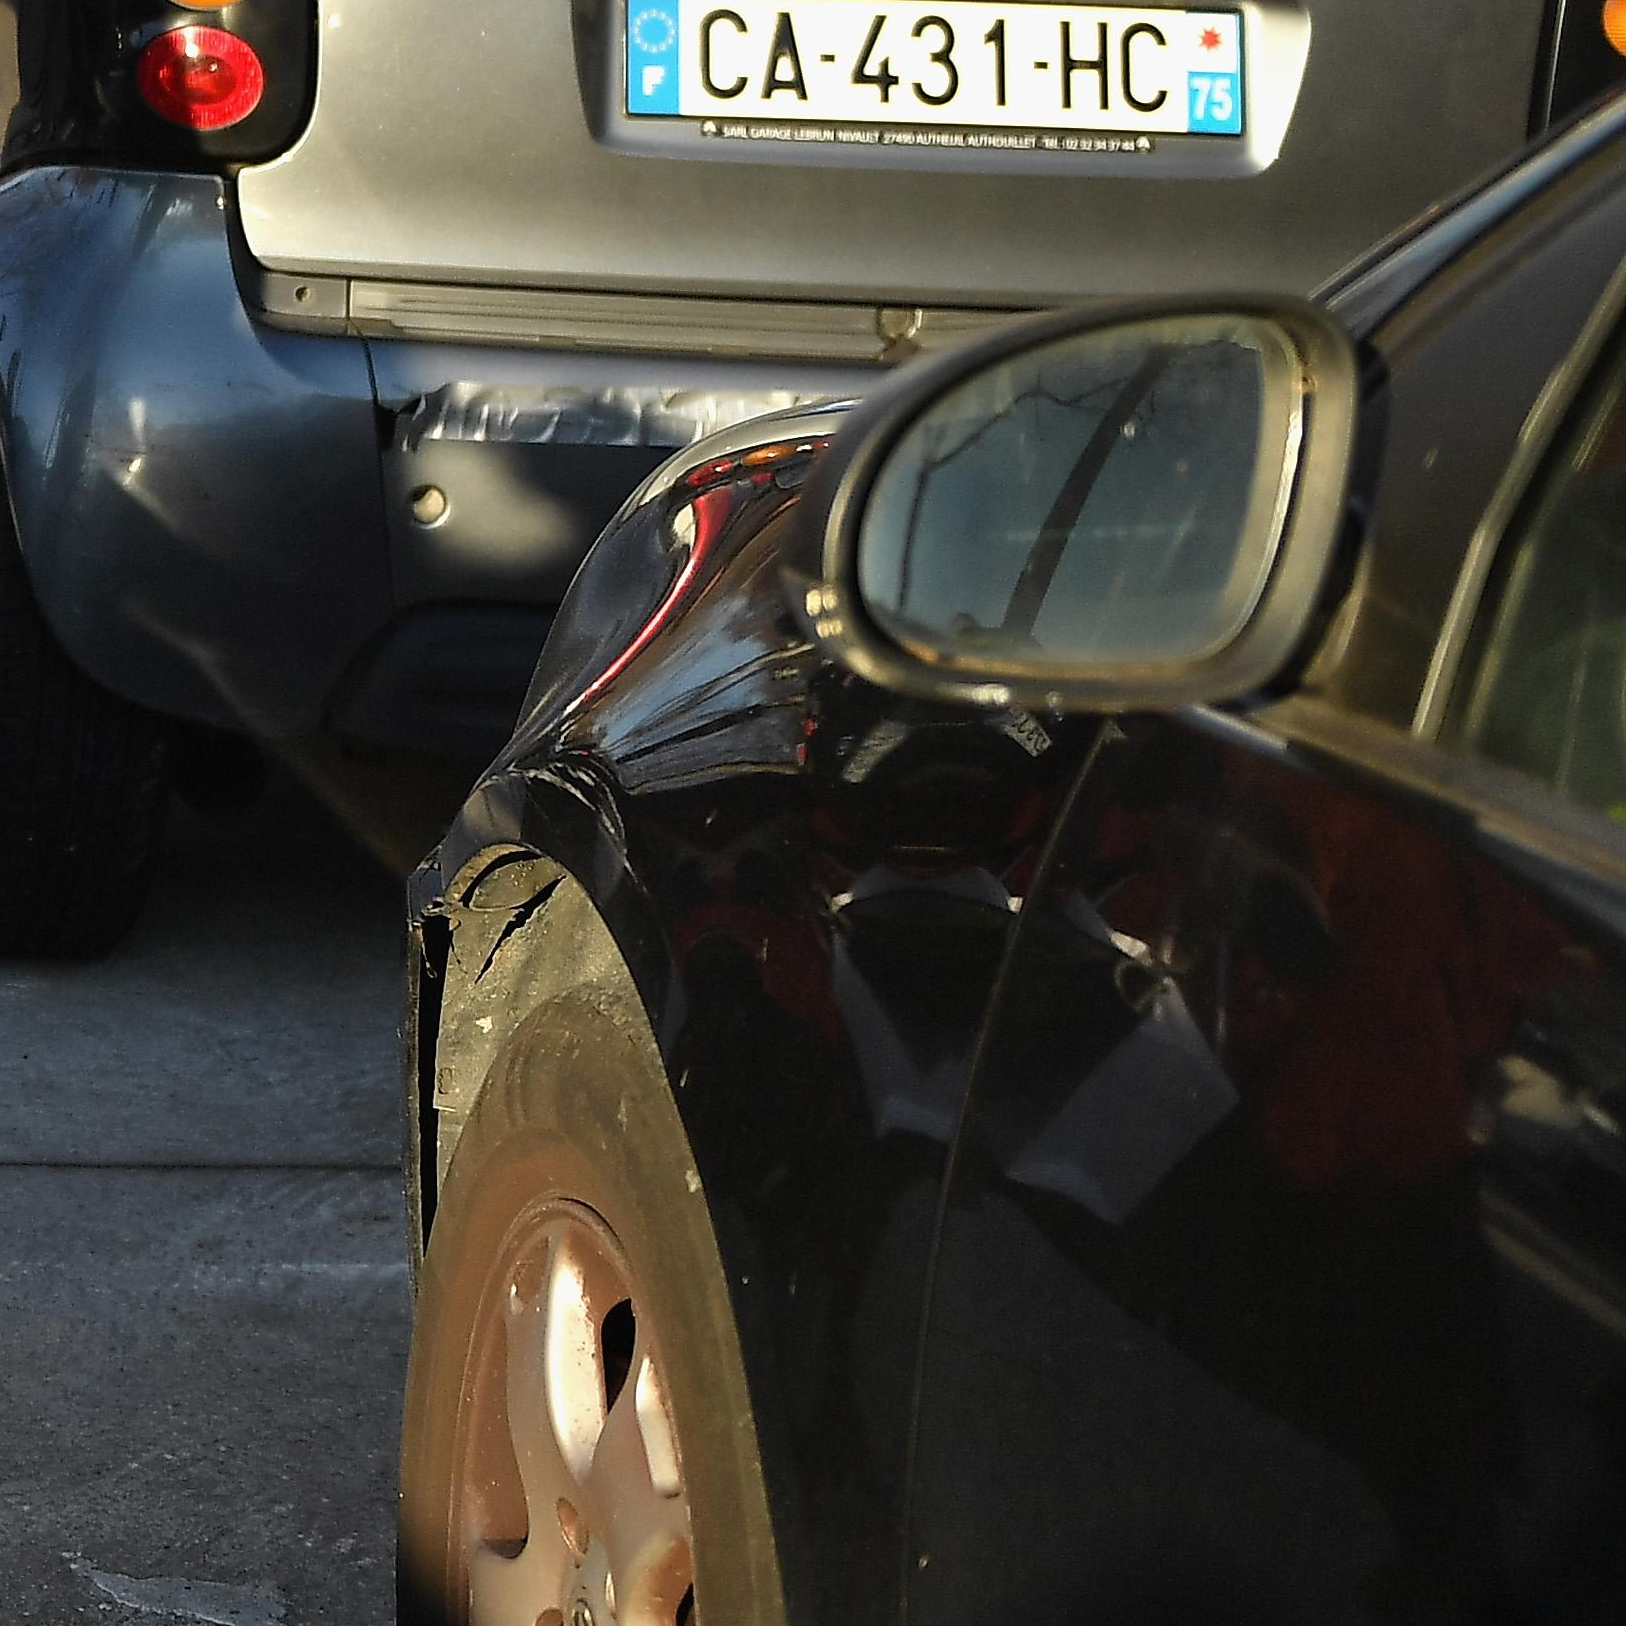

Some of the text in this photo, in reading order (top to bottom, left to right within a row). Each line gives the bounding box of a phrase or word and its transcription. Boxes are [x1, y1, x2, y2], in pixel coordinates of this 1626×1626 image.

[699, 8, 1169, 113] CA-431-HC
[1190, 78, 1234, 122] 75
[750, 126, 792, 141] GARAGE
